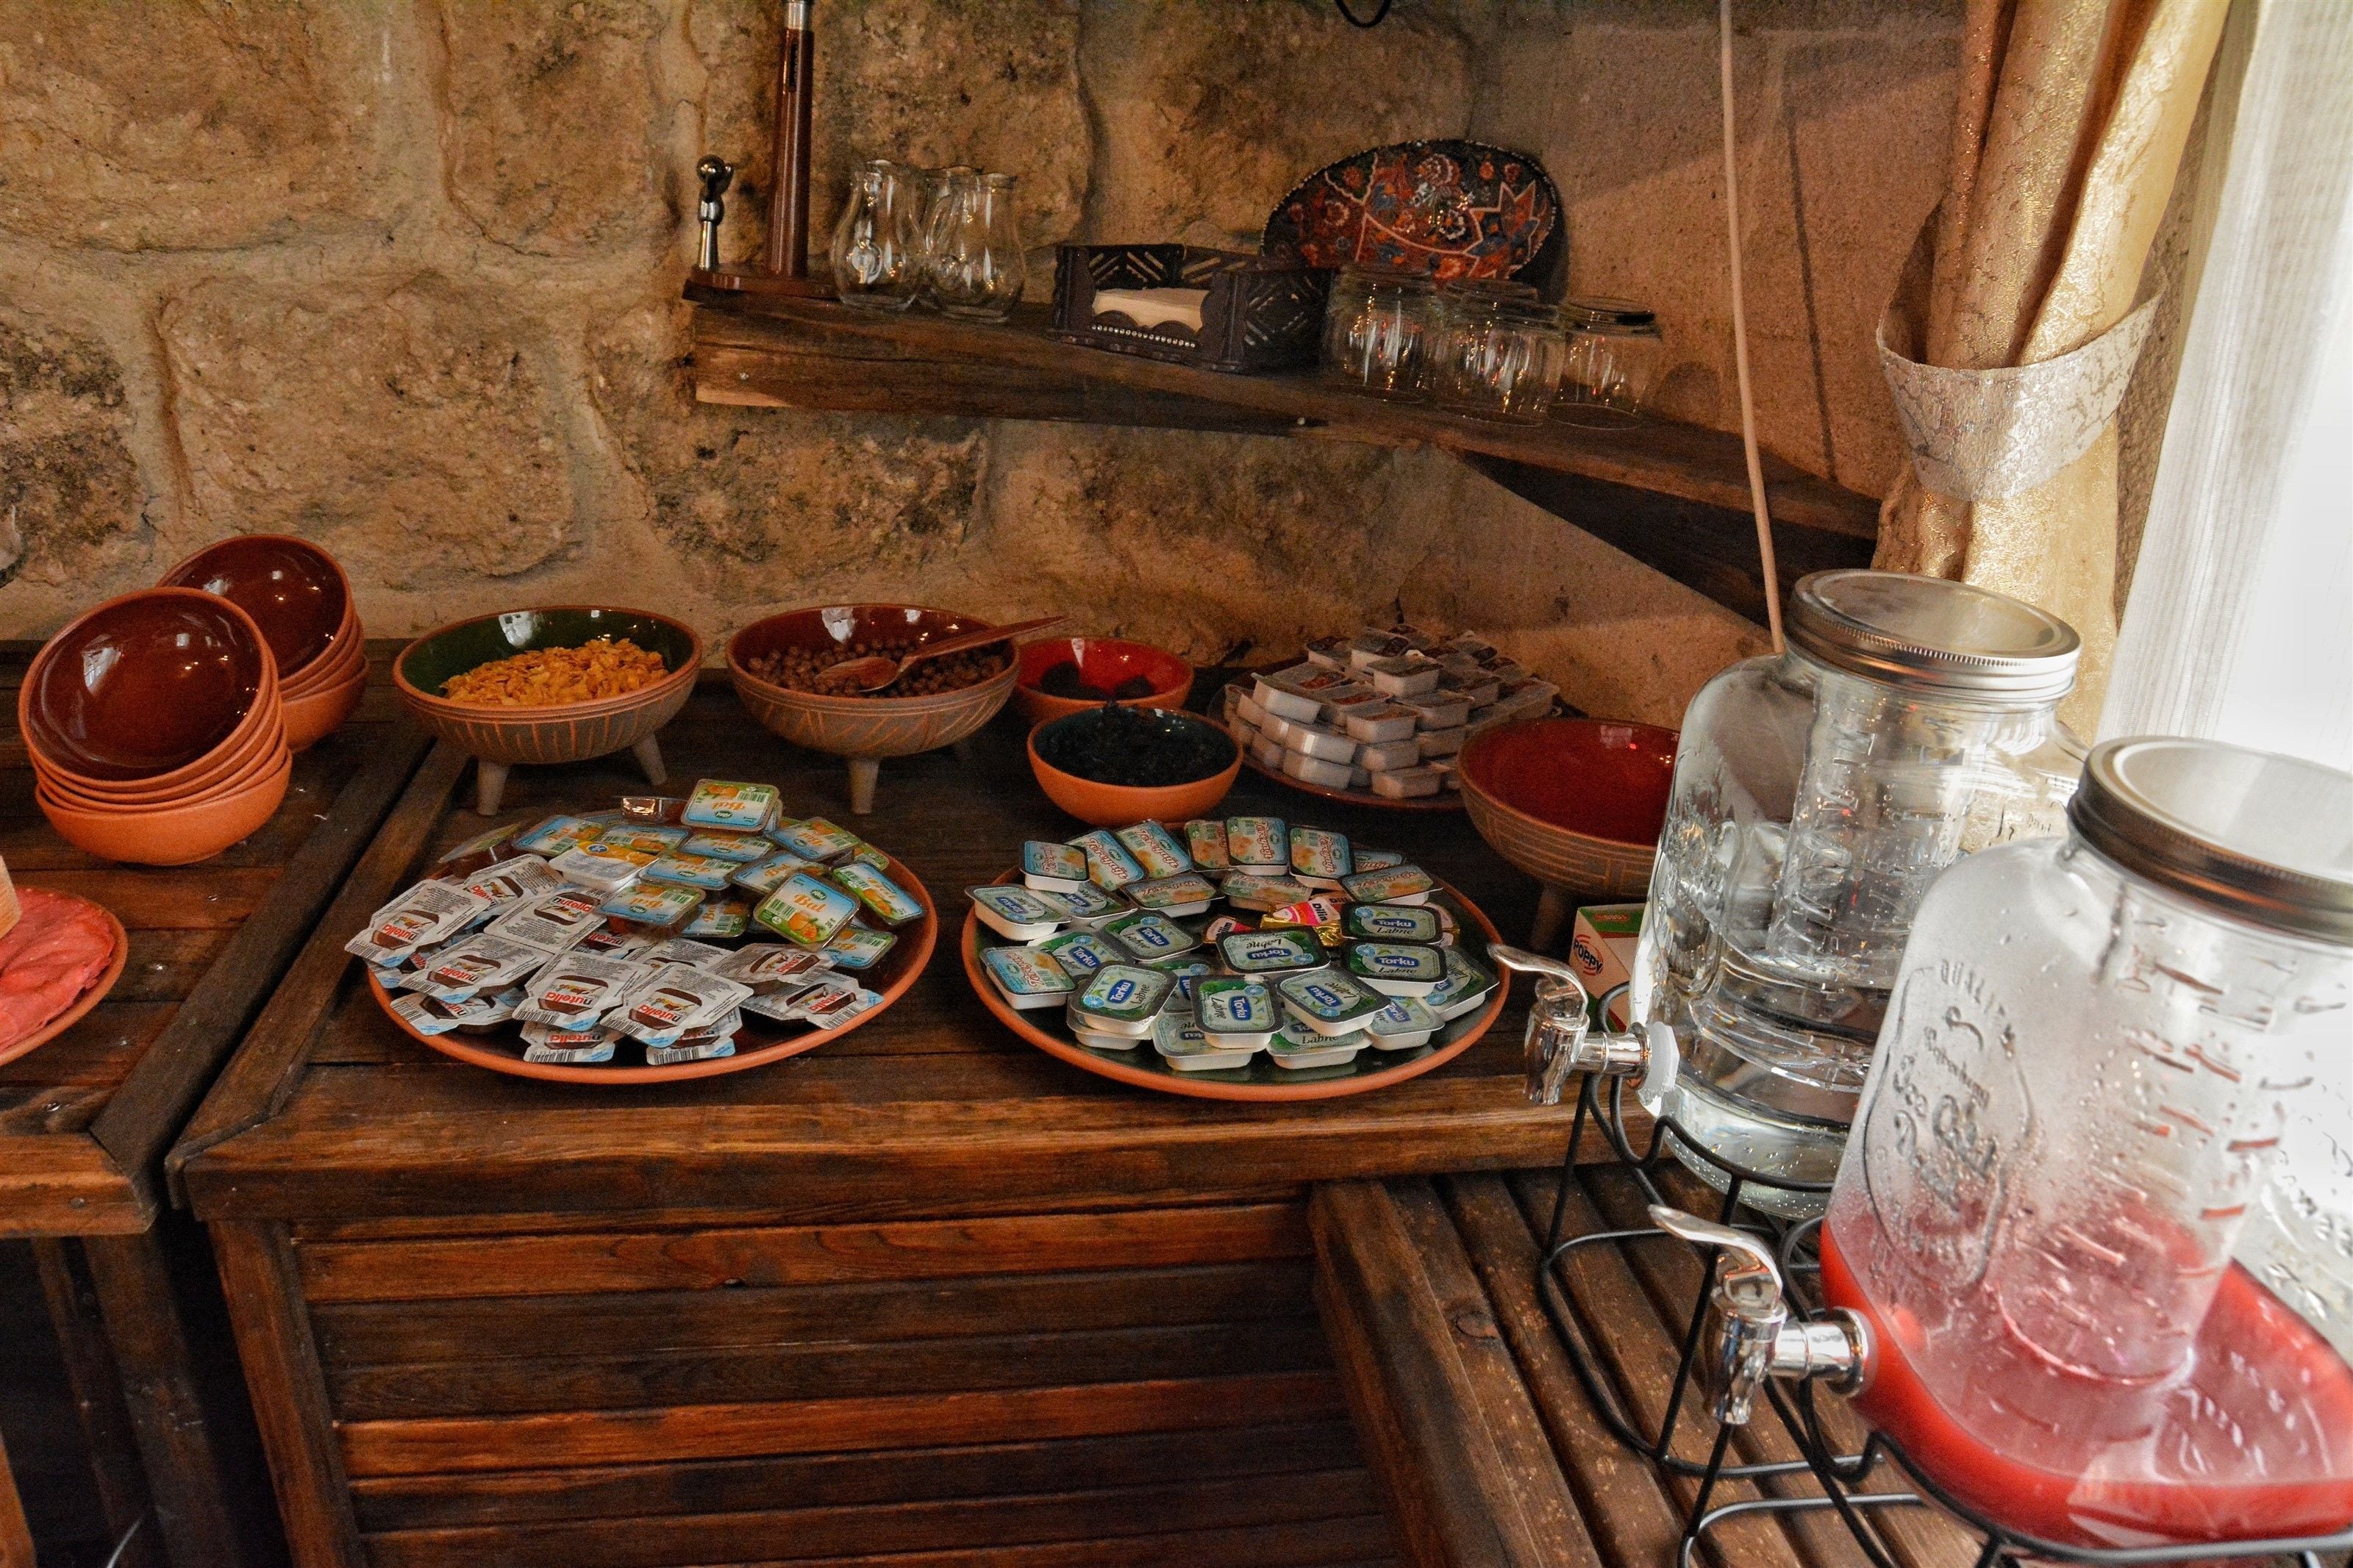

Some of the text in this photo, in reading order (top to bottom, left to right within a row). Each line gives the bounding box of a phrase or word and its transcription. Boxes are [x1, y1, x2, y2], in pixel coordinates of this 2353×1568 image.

[1136, 828, 1179, 868] Tereyağı
[1254, 820, 1275, 860] Tereyağı
[1085, 838, 1128, 880] Tereyağı
[1318, 834, 1337, 873] Tereyağı
[551, 897, 593, 913] nutella
[793, 893, 826, 912] Bal
[1000, 898, 1024, 914] Torku
[1376, 919, 1413, 928] Torku
[1377, 927, 1415, 935] Labne
[382, 924, 418, 941] nutella
[589, 932, 624, 946] nutell
[1142, 928, 1165, 945] Torku
[1246, 938, 1282, 949] Labne
[1073, 948, 1097, 967] Torku
[1252, 949, 1289, 959] Torku
[1379, 957, 1415, 966] Torku
[439, 967, 479, 982] nutella
[1378, 966, 1418, 974] Labne
[546, 992, 593, 1006] nutella
[809, 990, 846, 1011] nutella
[1110, 982, 1132, 1003] Torku
[1130, 984, 1151, 1005] Labne
[1310, 987, 1337, 1006] Torku
[638, 1004, 682, 1022] nutella
[1211, 997, 1227, 1020] Labne
[1233, 998, 1248, 1018] Torku
[549, 1034, 601, 1043] nutella
[1302, 1033, 1339, 1044] Labne
